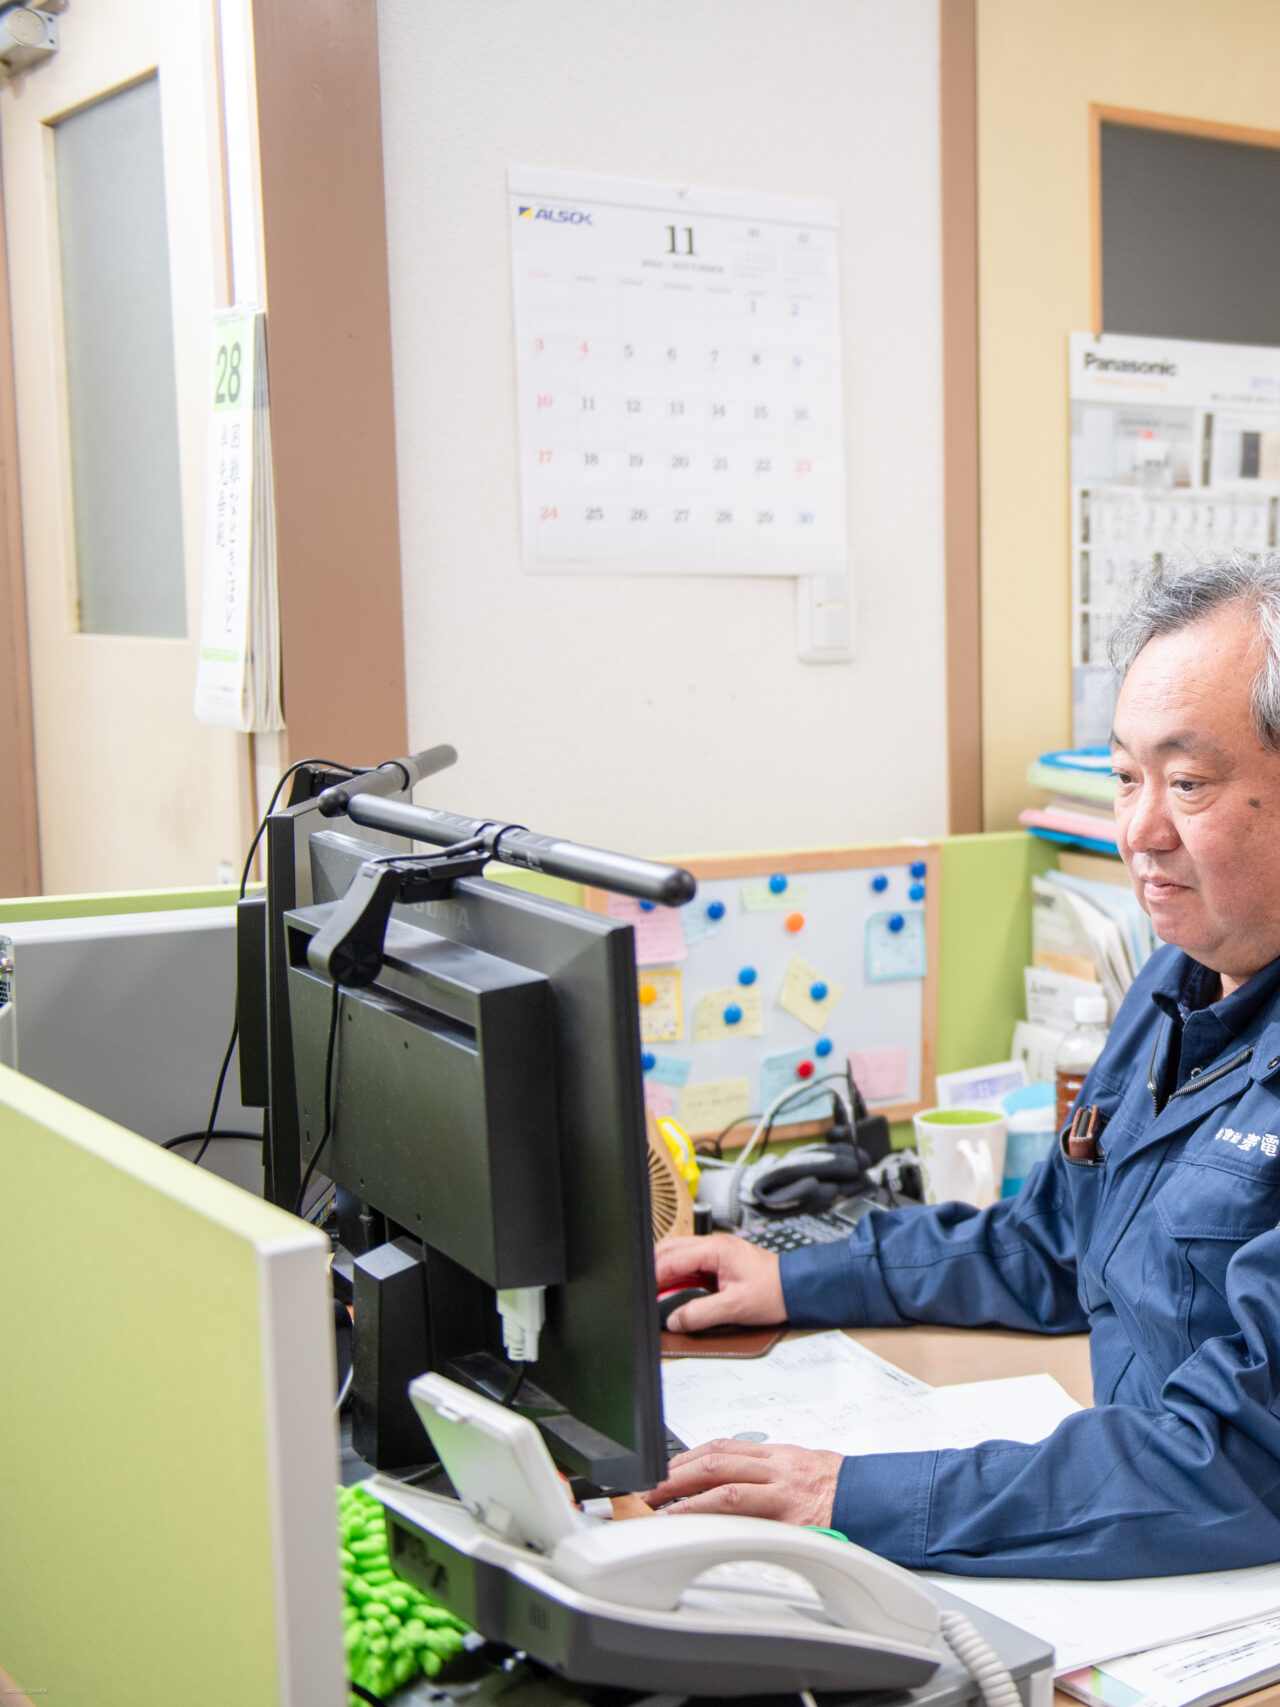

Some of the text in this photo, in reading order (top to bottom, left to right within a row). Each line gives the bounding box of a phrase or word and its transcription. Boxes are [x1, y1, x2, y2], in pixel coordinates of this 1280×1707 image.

[534, 208, 592, 226] ALSOK
[665, 225, 697, 257] 11
[623, 343, 634, 358] 5
[709, 349, 719, 363] 7
[1084, 351, 1177, 377] Panasonic
[214, 342, 242, 406] 28
[535, 393, 554, 409] 10
[581, 396, 595, 411] 11
[625, 399, 642, 413] 12
[670, 401, 685, 415] 13
[711, 404, 726, 417] 14
[753, 405, 769, 420] 15
[537, 449, 553, 465] 17
[583, 452, 599, 465] 18
[628, 454, 644, 467] 19
[671, 455, 690, 469] 20
[713, 456, 729, 471] 21
[754, 458, 771, 473] 22
[539, 506, 559, 521] 24
[584, 507, 604, 521] 25
[629, 509, 648, 522] 26
[673, 509, 690, 523] 27
[715, 510, 733, 524] 28
[756, 511, 774, 525] 29
